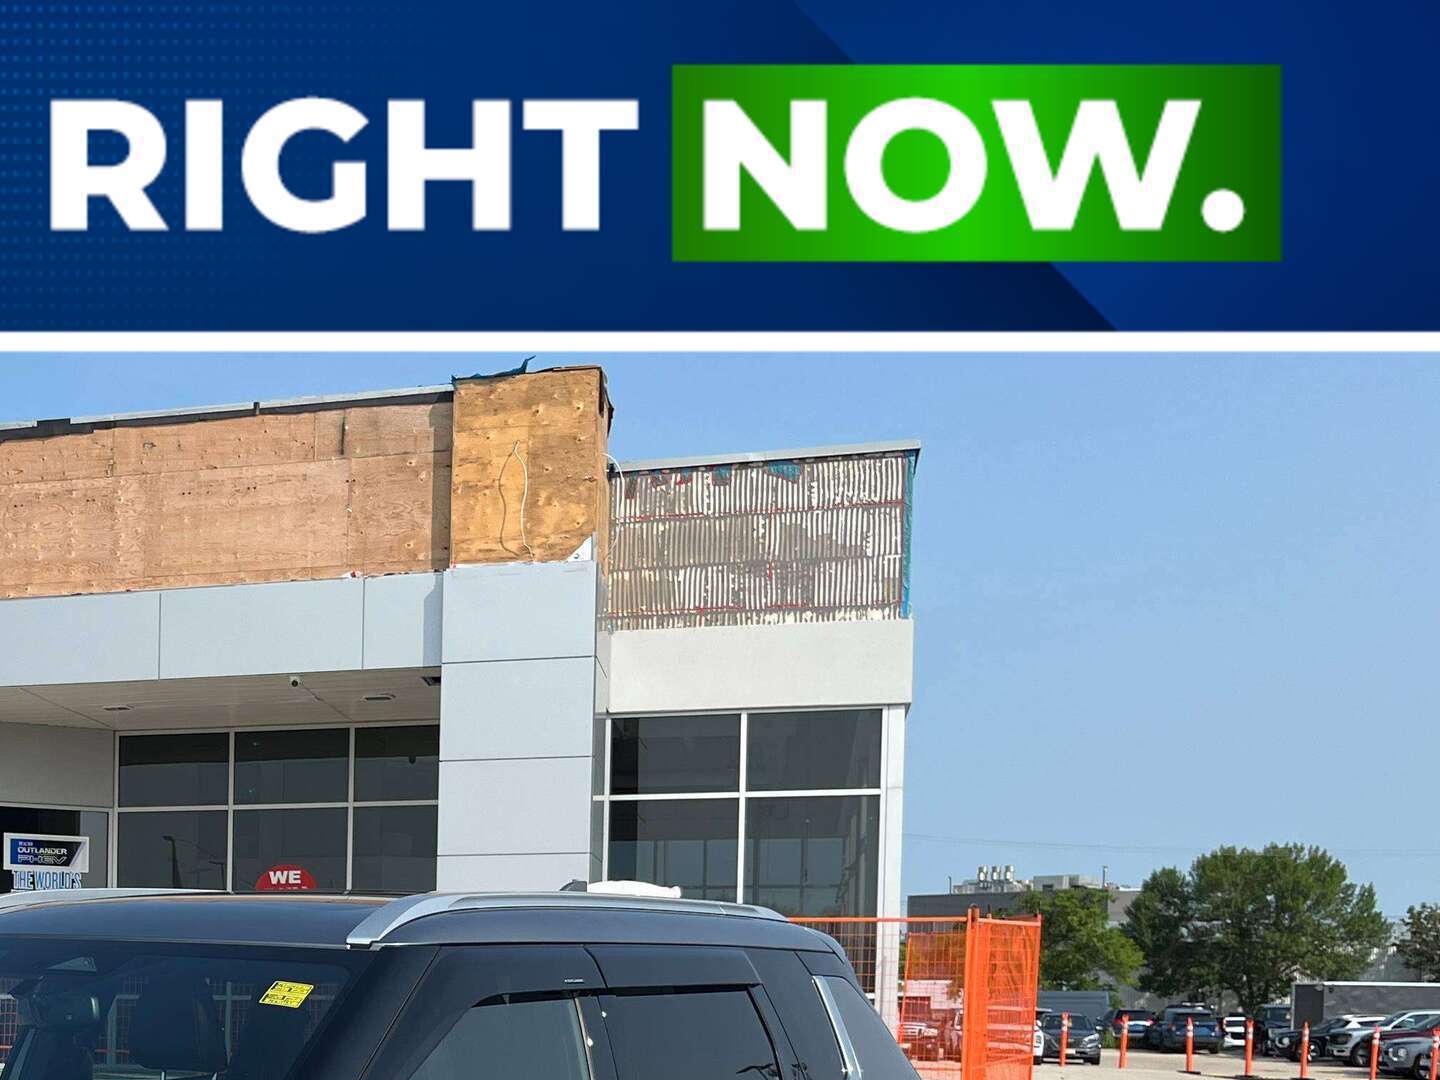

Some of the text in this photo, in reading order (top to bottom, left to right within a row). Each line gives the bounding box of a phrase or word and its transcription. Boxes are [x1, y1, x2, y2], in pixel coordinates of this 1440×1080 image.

[18, 847, 68, 855] OUTLANDER
[18, 855, 68, 865] PHEV
[14, 871, 81, 889] THE WORLD'S
[269, 870, 301, 885] WE
